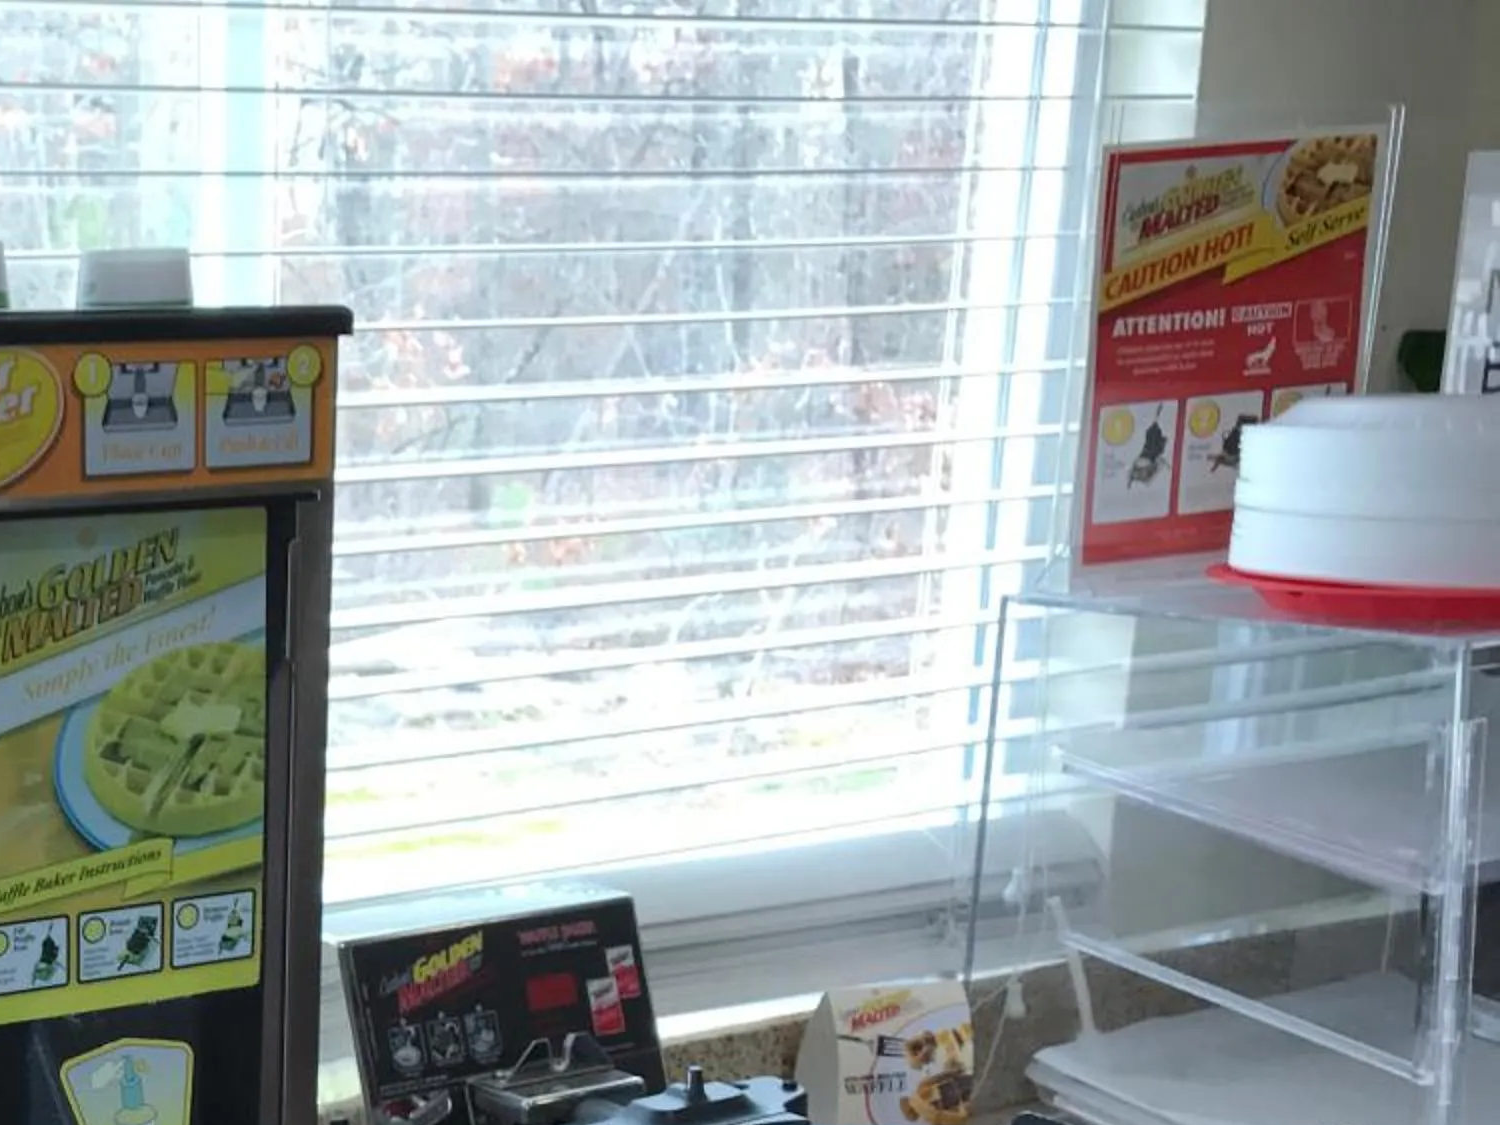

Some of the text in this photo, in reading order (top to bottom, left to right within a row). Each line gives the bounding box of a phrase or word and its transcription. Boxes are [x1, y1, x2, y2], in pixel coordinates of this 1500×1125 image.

[1138, 192, 1222, 242] MALTED
[1284, 205, 1367, 253] Self Serve
[1104, 223, 1255, 301] CAUTION HOT!
[1111, 308, 1226, 338] ATTENTION!
[36, 527, 181, 613] GOLDEN
[0, 573, 145, 665] MALTED
[34, 870, 77, 893] Baker
[79, 848, 163, 882] Instructions
